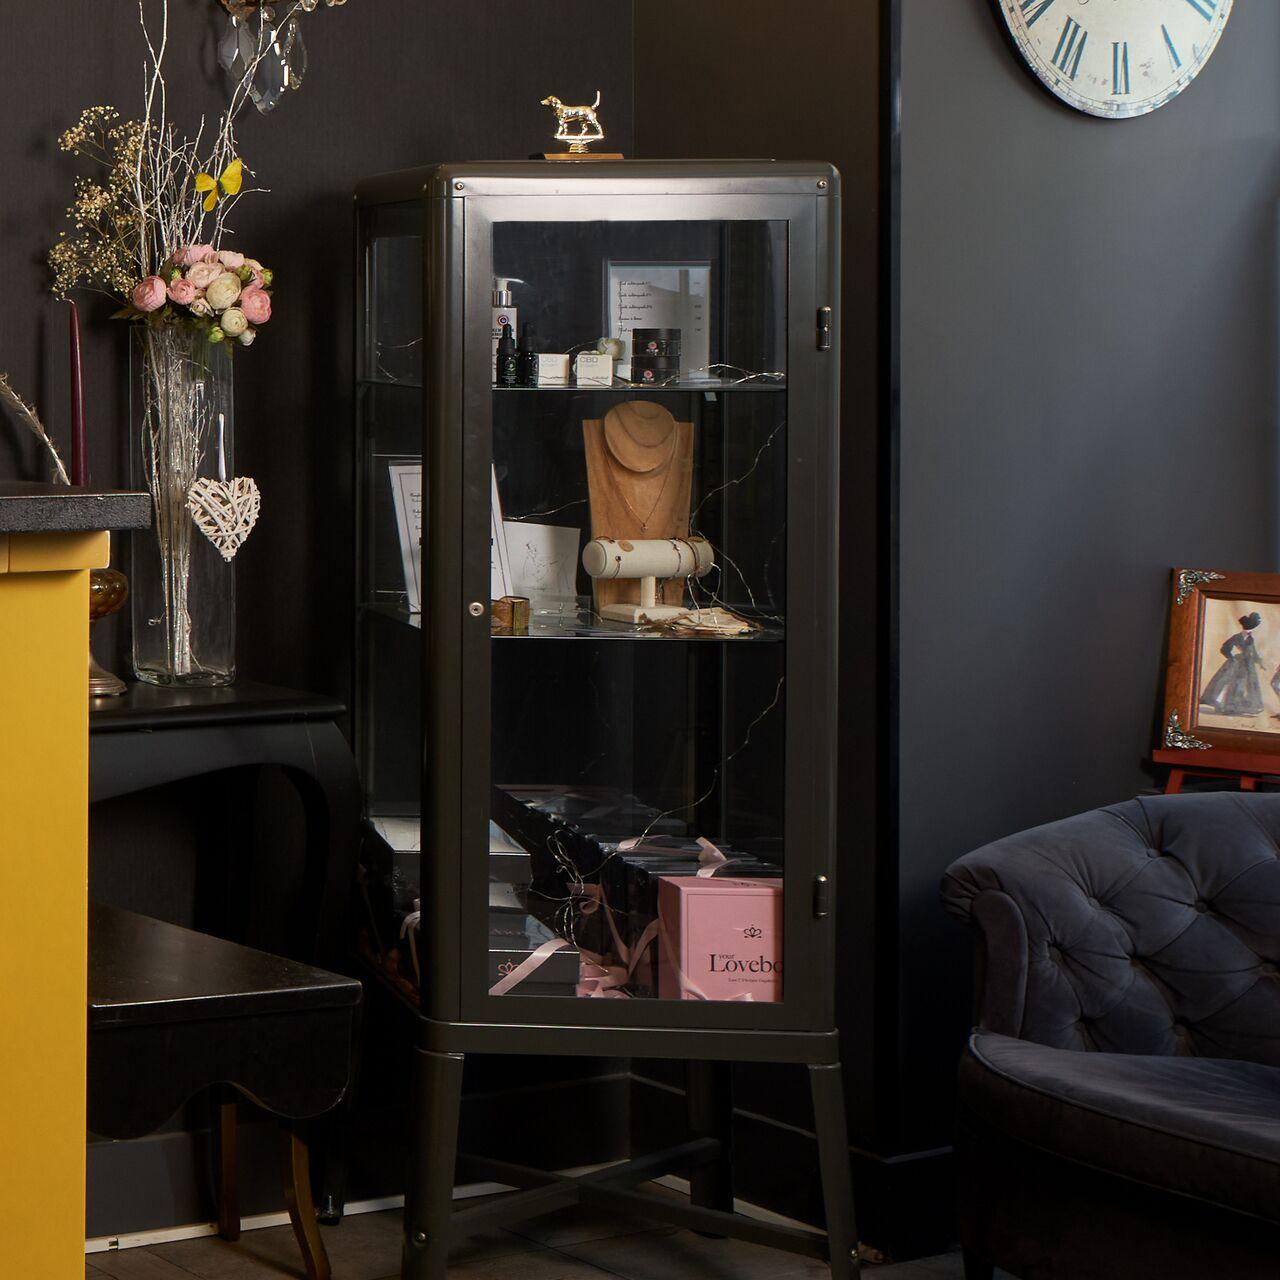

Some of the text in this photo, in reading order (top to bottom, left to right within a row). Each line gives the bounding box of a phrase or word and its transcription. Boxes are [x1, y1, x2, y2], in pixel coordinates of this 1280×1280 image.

[1049, 15, 1088, 81] VII
[1111, 41, 1130, 96] VI
[1160, 23, 1182, 73] V
